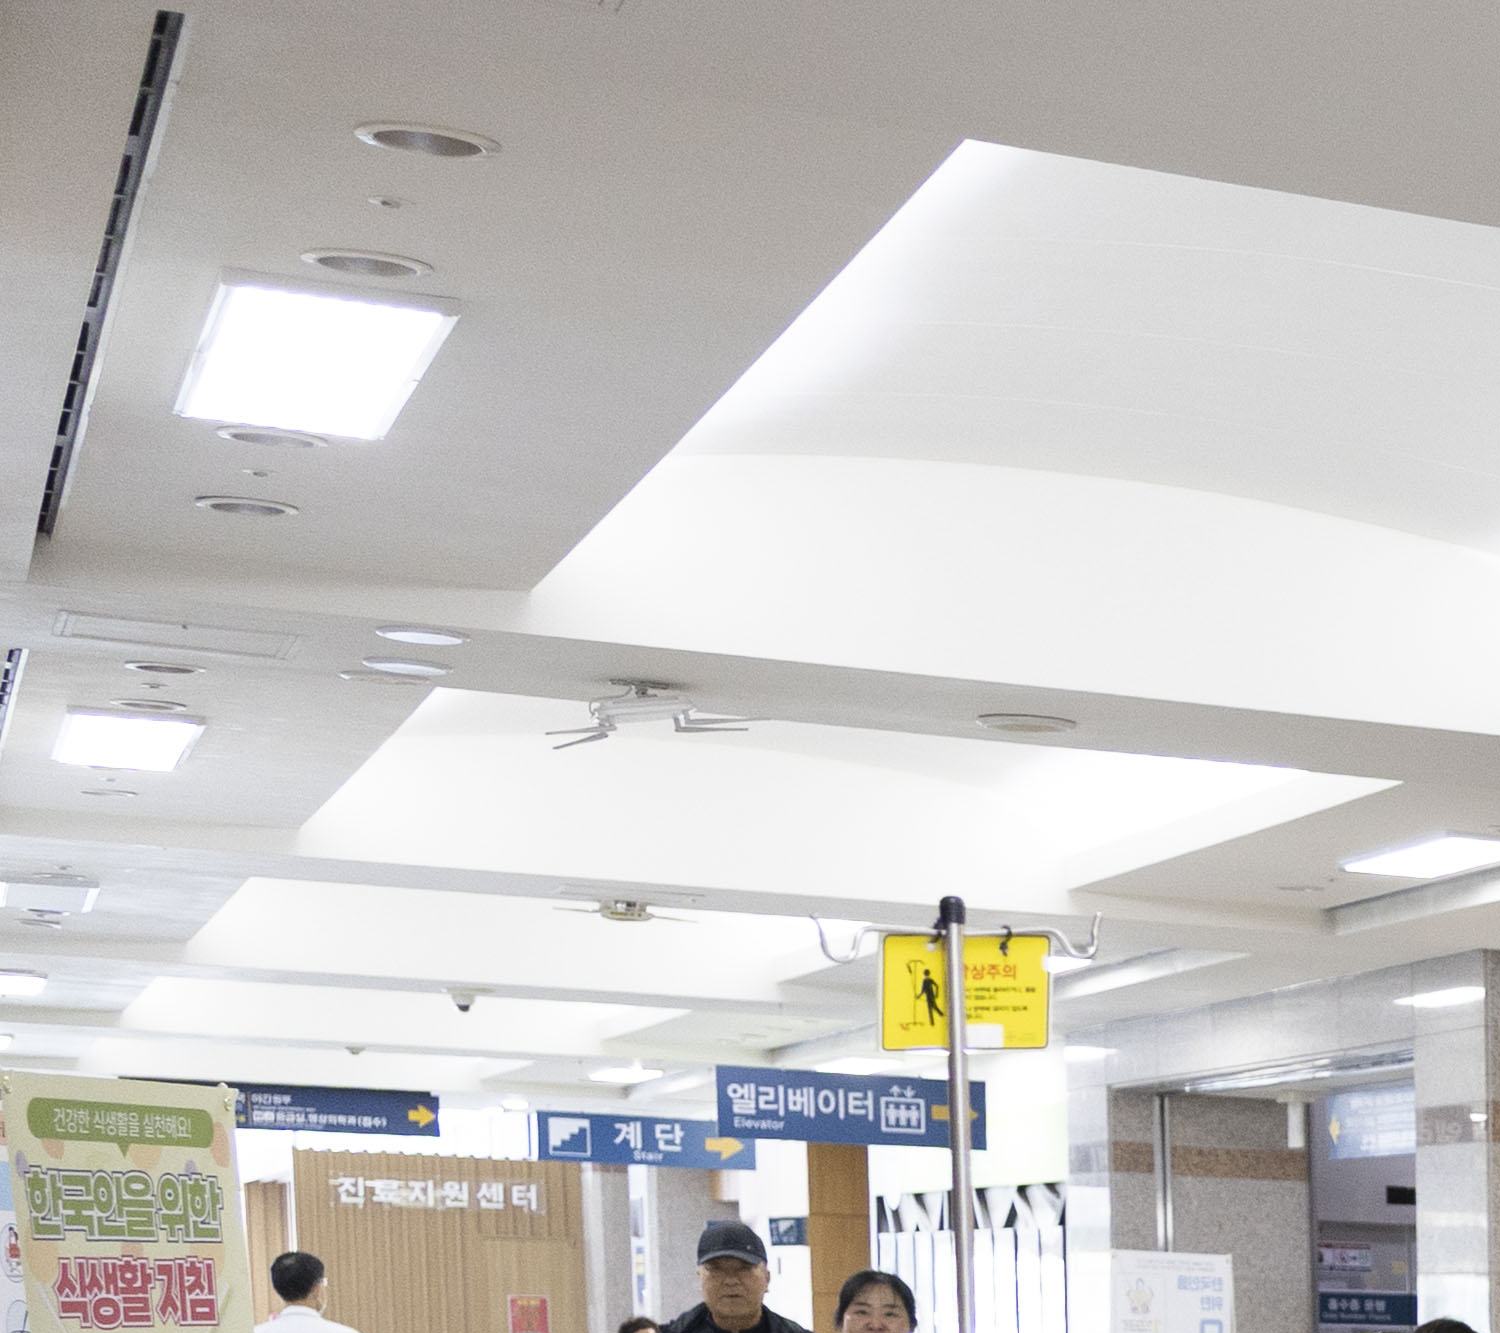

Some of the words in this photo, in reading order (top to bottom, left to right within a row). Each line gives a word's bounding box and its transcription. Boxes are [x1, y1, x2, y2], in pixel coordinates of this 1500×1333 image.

[727, 1083, 874, 1121] 엘리베이터
[54, 1107, 89, 1134] 건강한
[93, 1114, 140, 1137] 식생활을
[143, 1120, 192, 1140] 실천해요!
[734, 1117, 785, 1131] Elevator
[633, 1149, 664, 1163] Stair
[25, 1165, 158, 1241] 한국인을
[156, 1172, 223, 1242] 위한
[54, 1256, 154, 1329] 식생활
[154, 1256, 219, 1326] 지침
